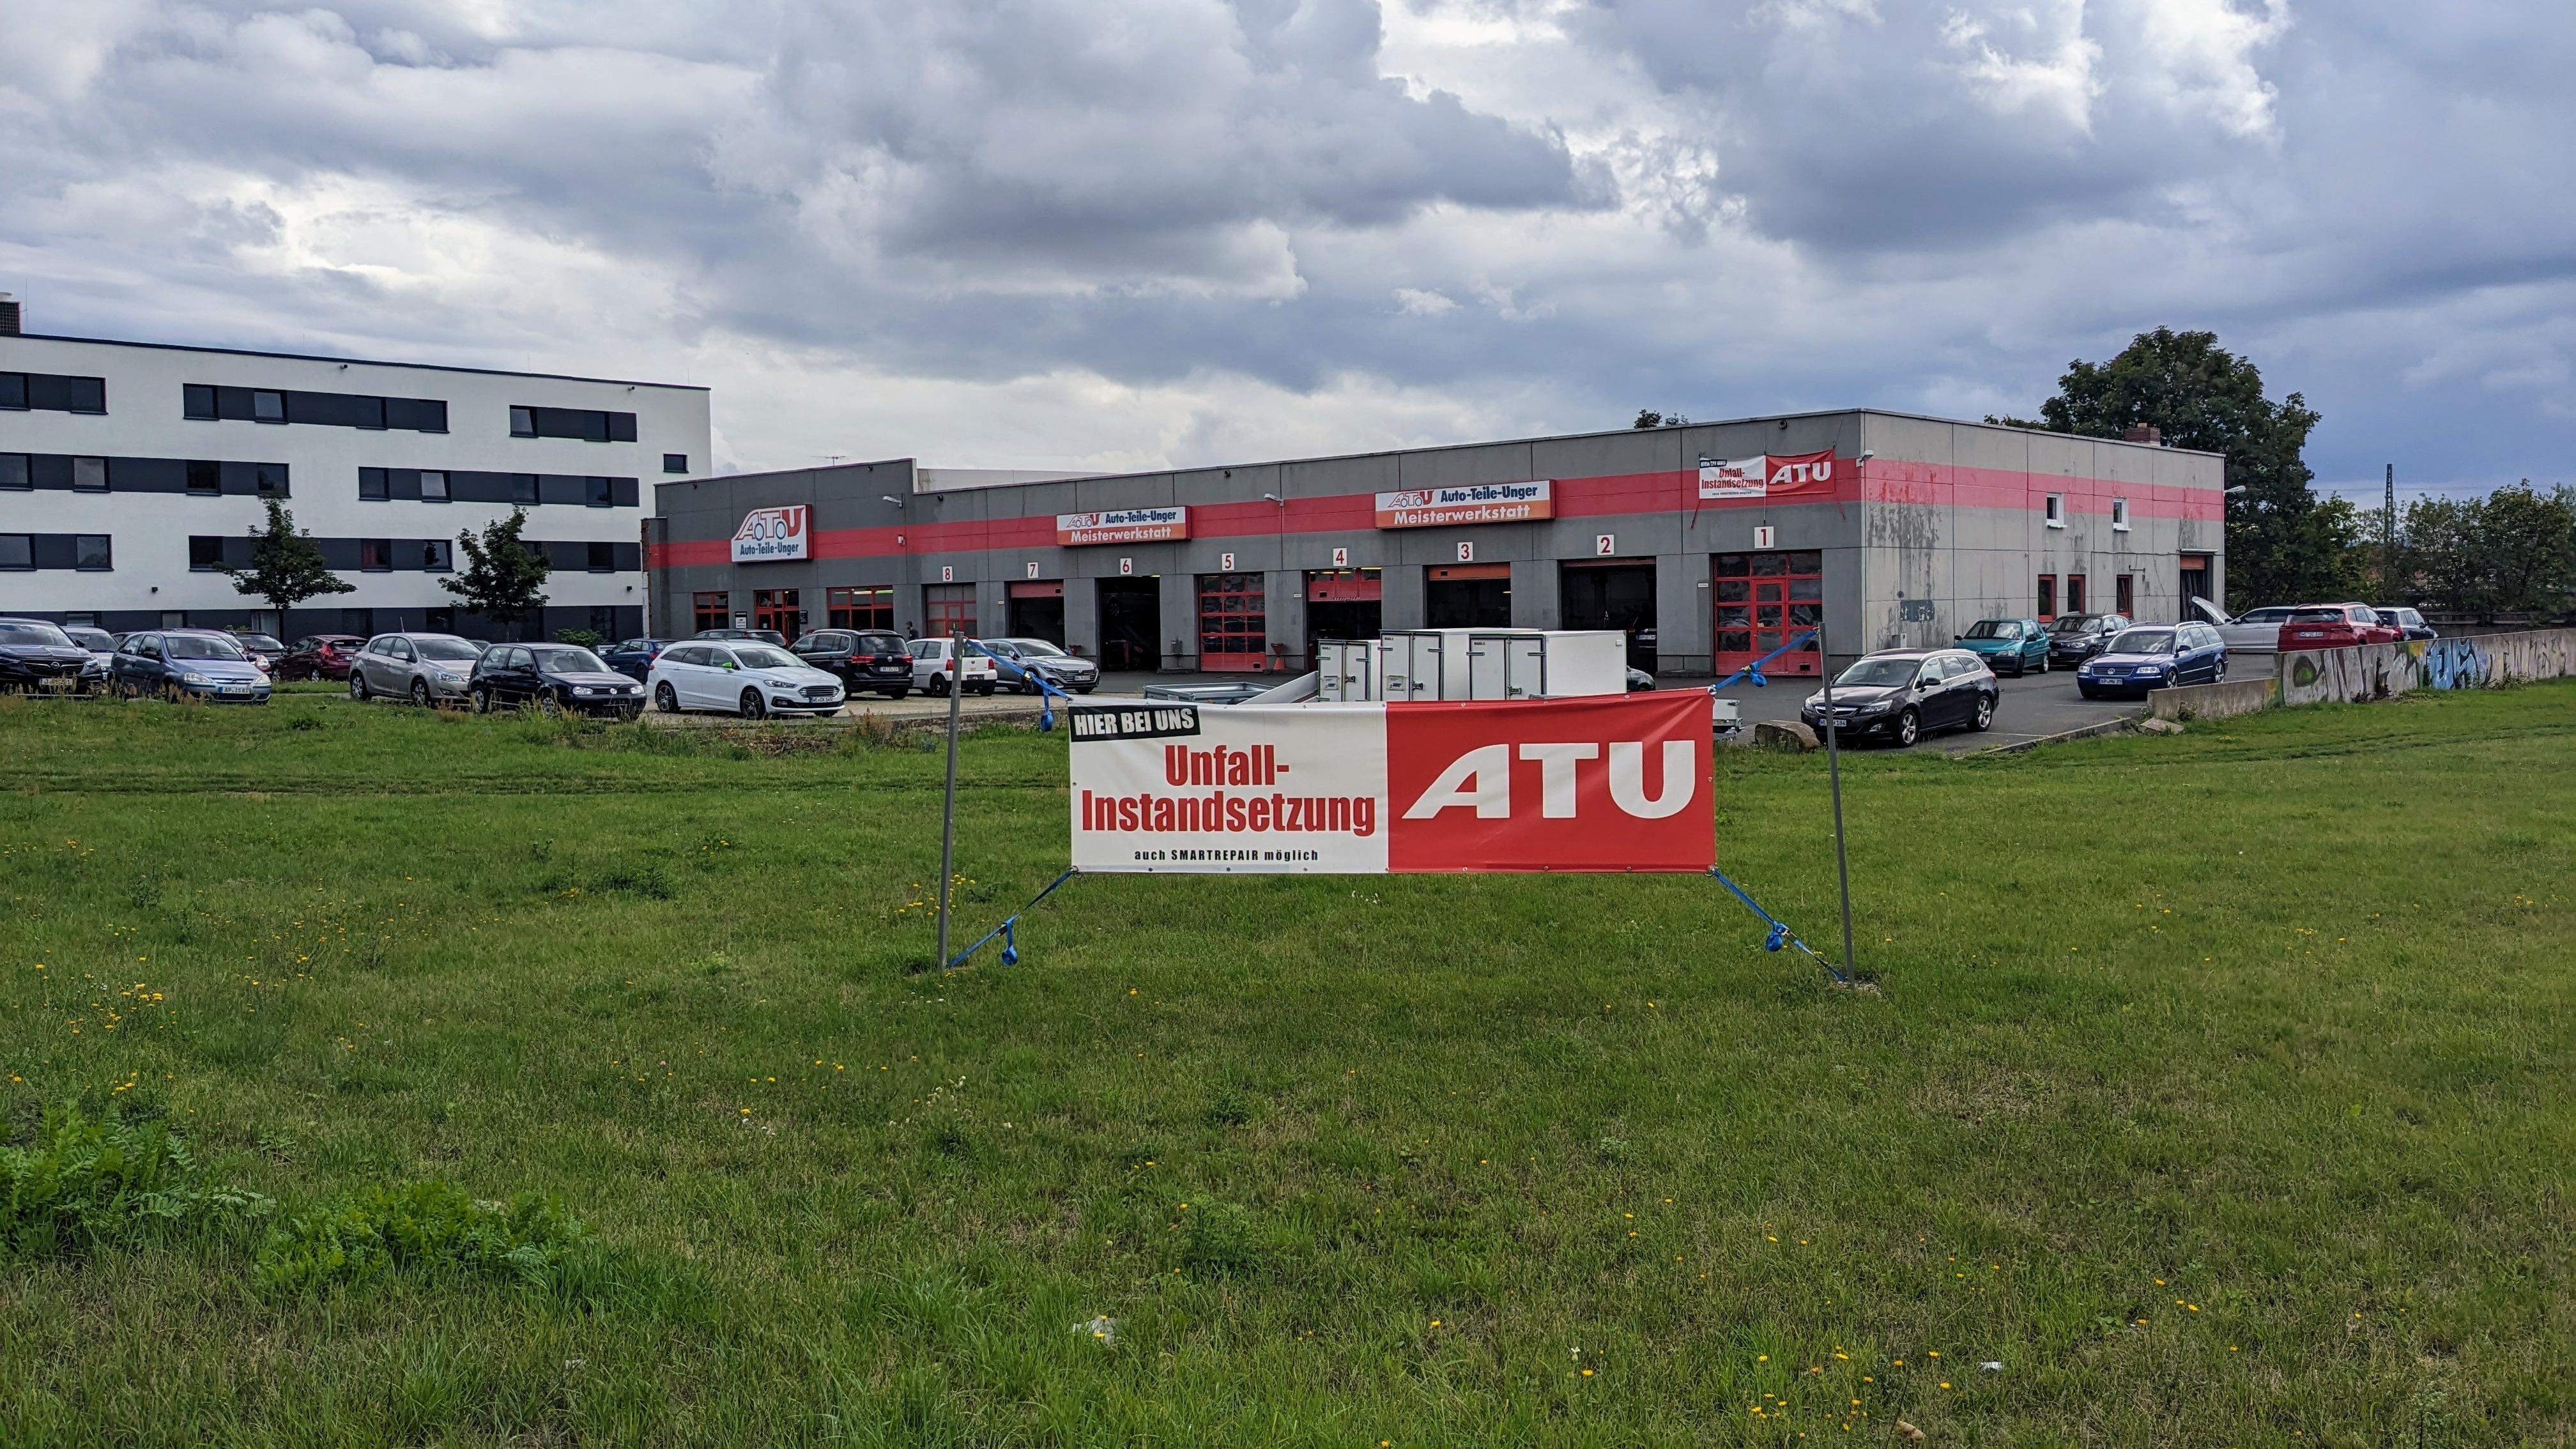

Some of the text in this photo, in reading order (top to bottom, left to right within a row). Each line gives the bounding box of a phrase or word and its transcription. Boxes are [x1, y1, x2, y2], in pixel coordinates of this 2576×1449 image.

[1719, 468, 1745, 479] Unfall-
[1769, 461, 1831, 484] ATU
[1441, 486, 1538, 503] Auto-Teile-Unger
[1105, 510, 1177, 523] Auto-Teile-Unger
[1394, 504, 1531, 525] Meisterwerkstatt
[1071, 526, 1171, 542] Meisterwerkstatt
[1761, 529, 1767, 546] 1
[740, 542, 799, 556] Auto-Teile-Unger
[1461, 544, 1469, 559] 3
[1600, 537, 1611, 553] 2
[1225, 555, 1232, 569] 5
[1335, 549, 1344, 564] 4
[945, 567, 950, 580] 8
[1030, 564, 1036, 577] 7
[1123, 559, 1130, 573] 6
[1073, 708, 1195, 736] HIER BEI UNS
[1165, 744, 1289, 786] Unfall-
[1401, 740, 1696, 819] ATU
[1082, 790, 1375, 837] Instandsetzung
[1135, 849, 1319, 862] auch SMARTREPAIR möglich
